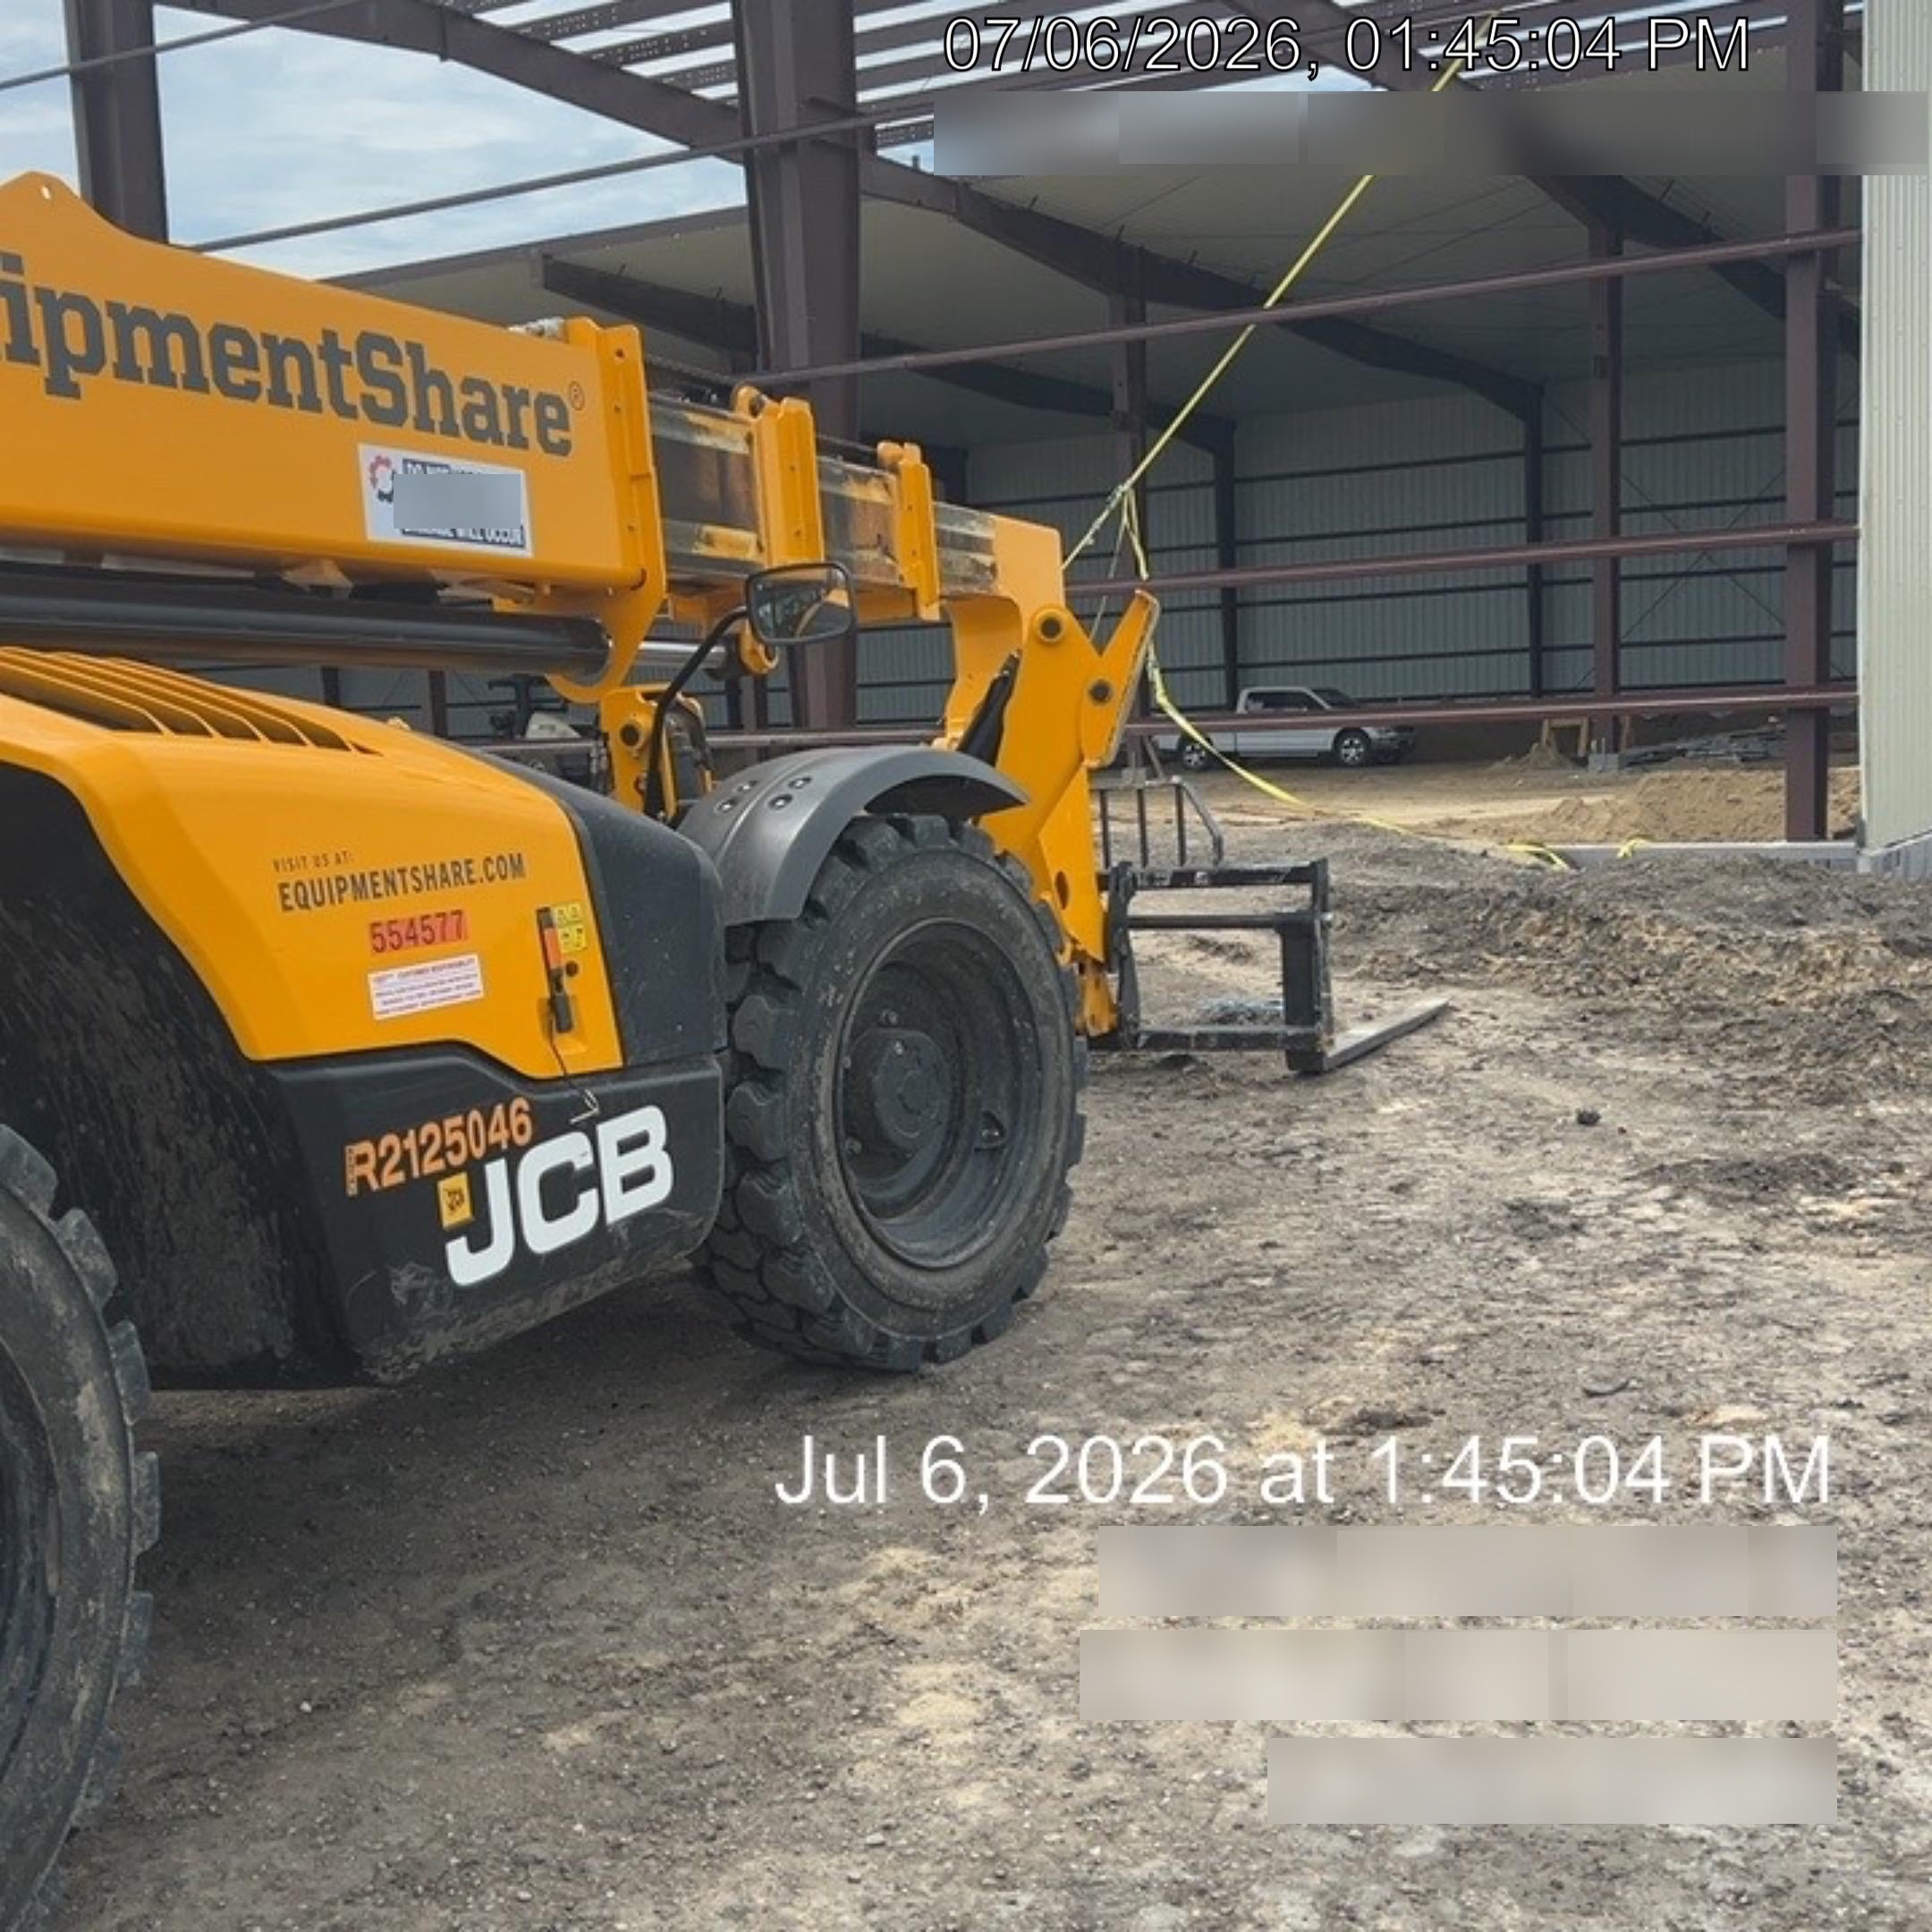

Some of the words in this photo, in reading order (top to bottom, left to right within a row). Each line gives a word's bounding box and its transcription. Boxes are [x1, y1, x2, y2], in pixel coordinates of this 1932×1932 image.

[273, 855, 308, 873] VISIT
[314, 852, 329, 869] US
[335, 851, 355, 866] AT:
[278, 852, 526, 912] EQUIPMENTSHARE.COM
[369, 909, 464, 953] 554577
[345, 1097, 533, 1197] R2125046
[445, 1105, 674, 1286] JCB
